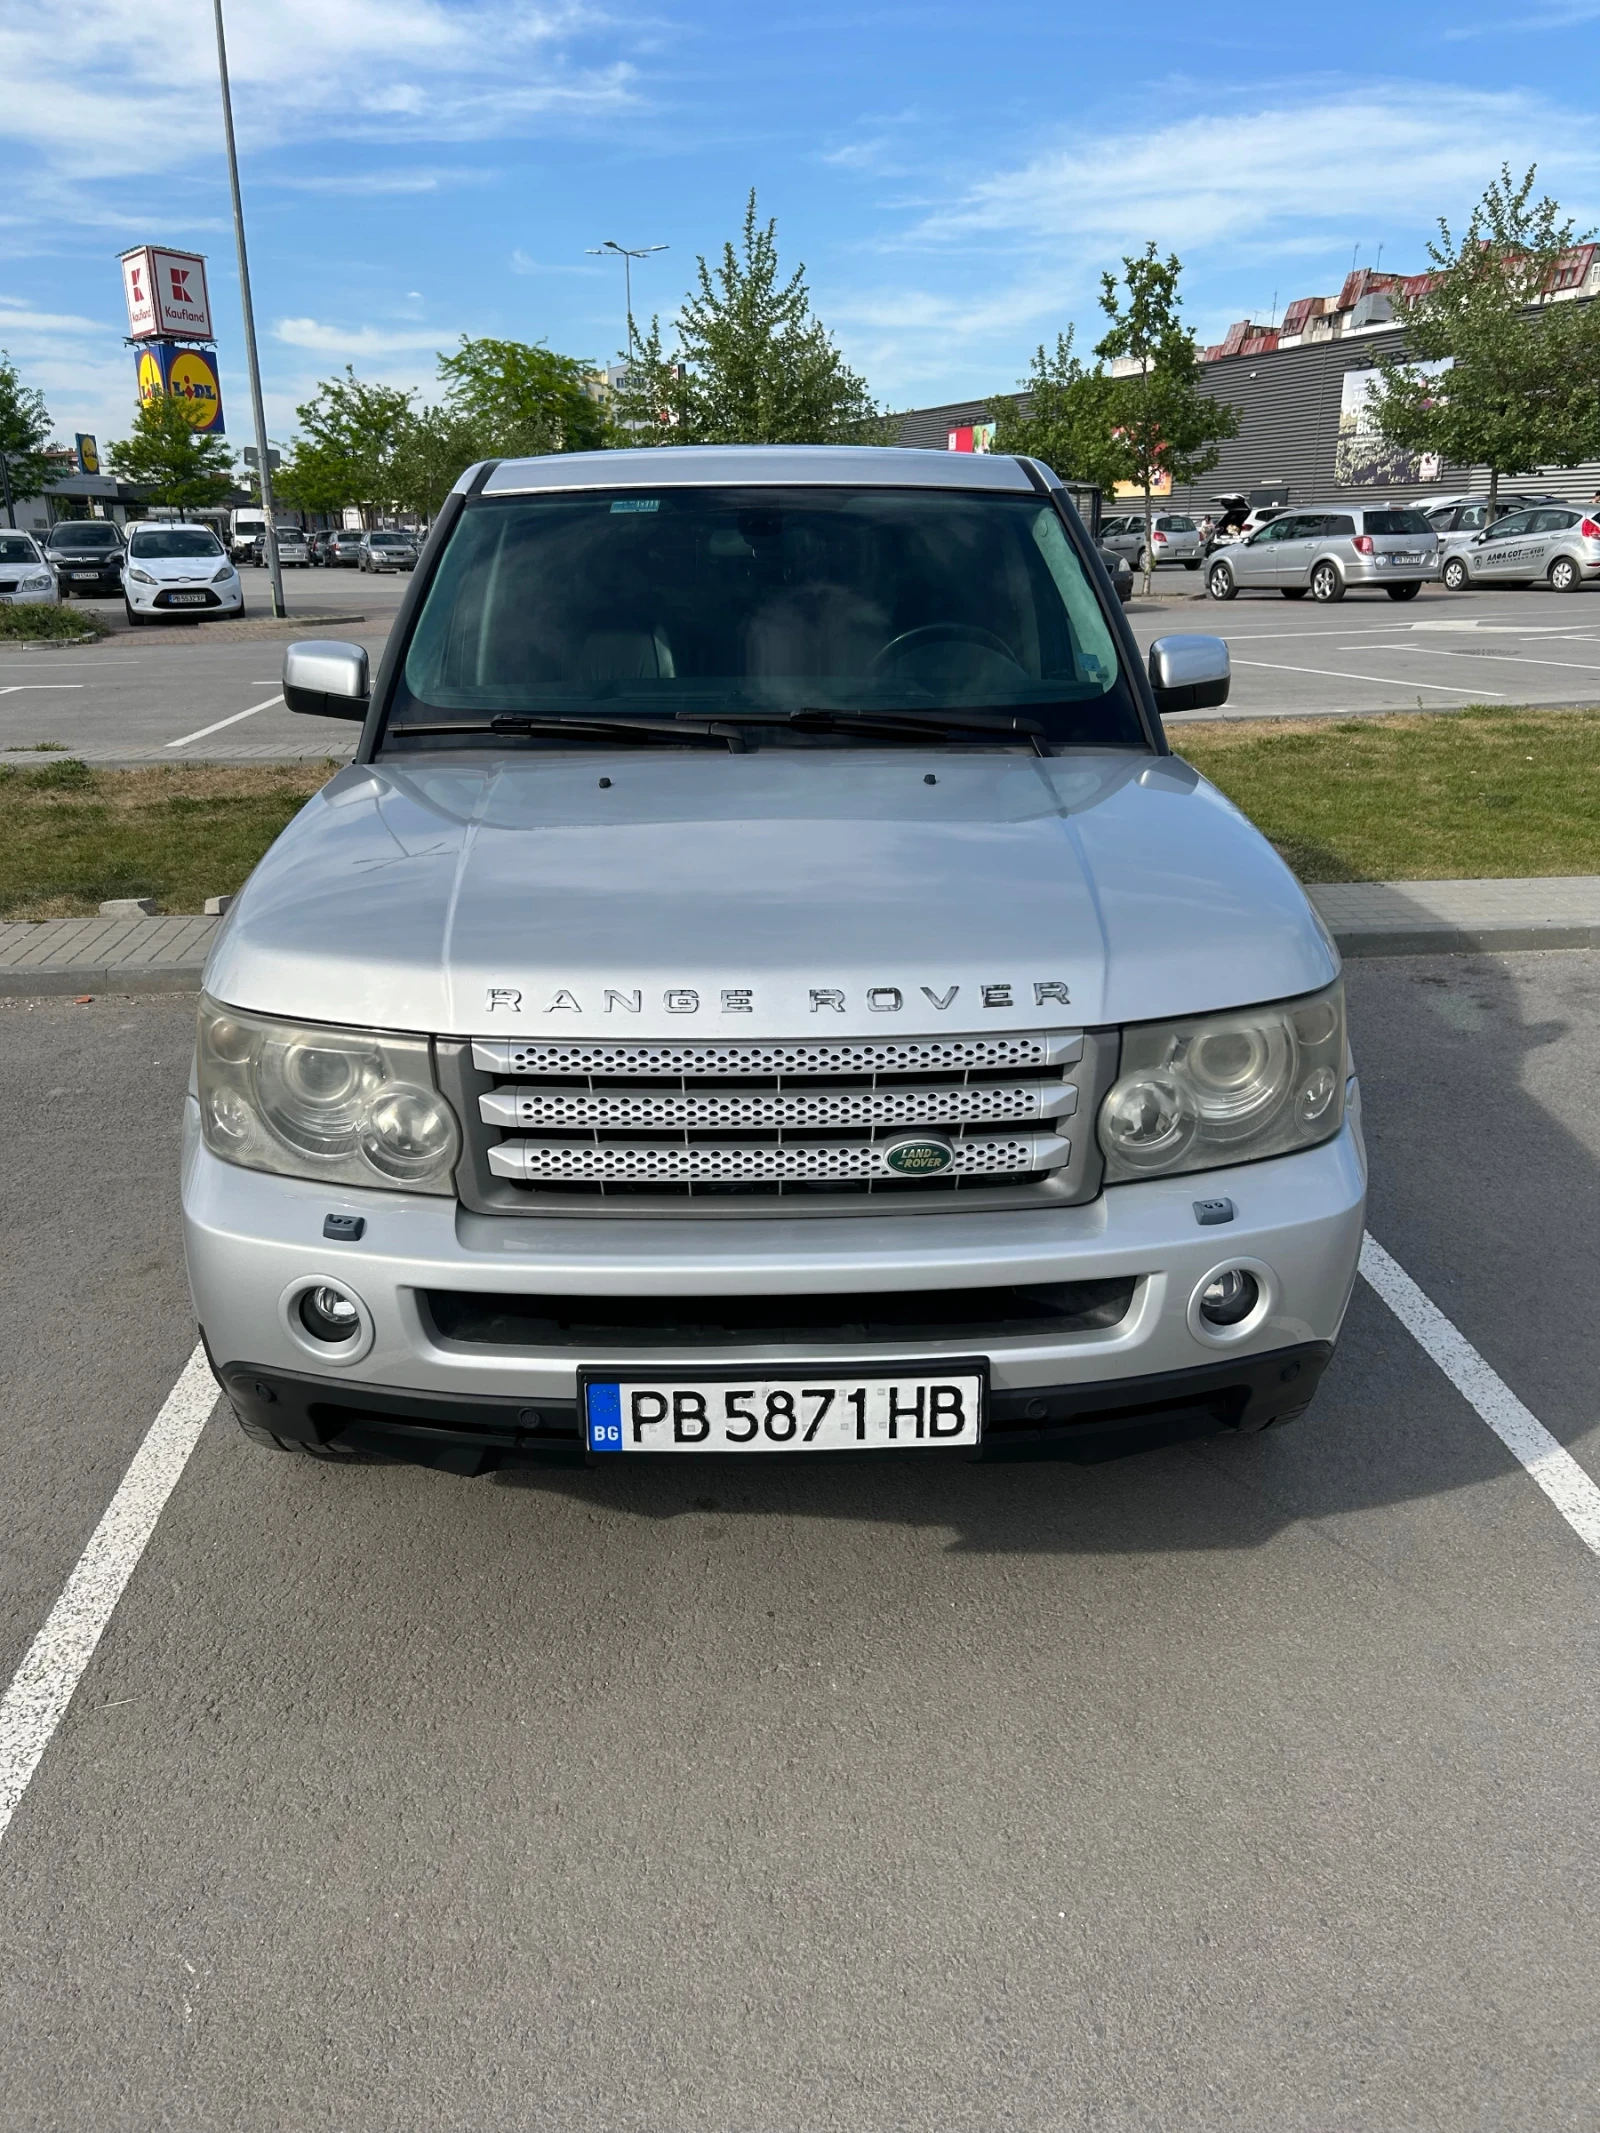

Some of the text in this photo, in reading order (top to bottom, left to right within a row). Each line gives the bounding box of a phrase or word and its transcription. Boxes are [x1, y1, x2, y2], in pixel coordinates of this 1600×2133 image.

[170, 268, 194, 303] K
[165, 305, 205, 323] Kaufland
[1507, 549, 1523, 558] СОТ
[485, 981, 1072, 1013] RANGE ROVER
[901, 1148, 932, 1159] LAND
[904, 1158, 942, 1168] ROVER
[593, 1384, 966, 1443] BG PB 5871 HB
